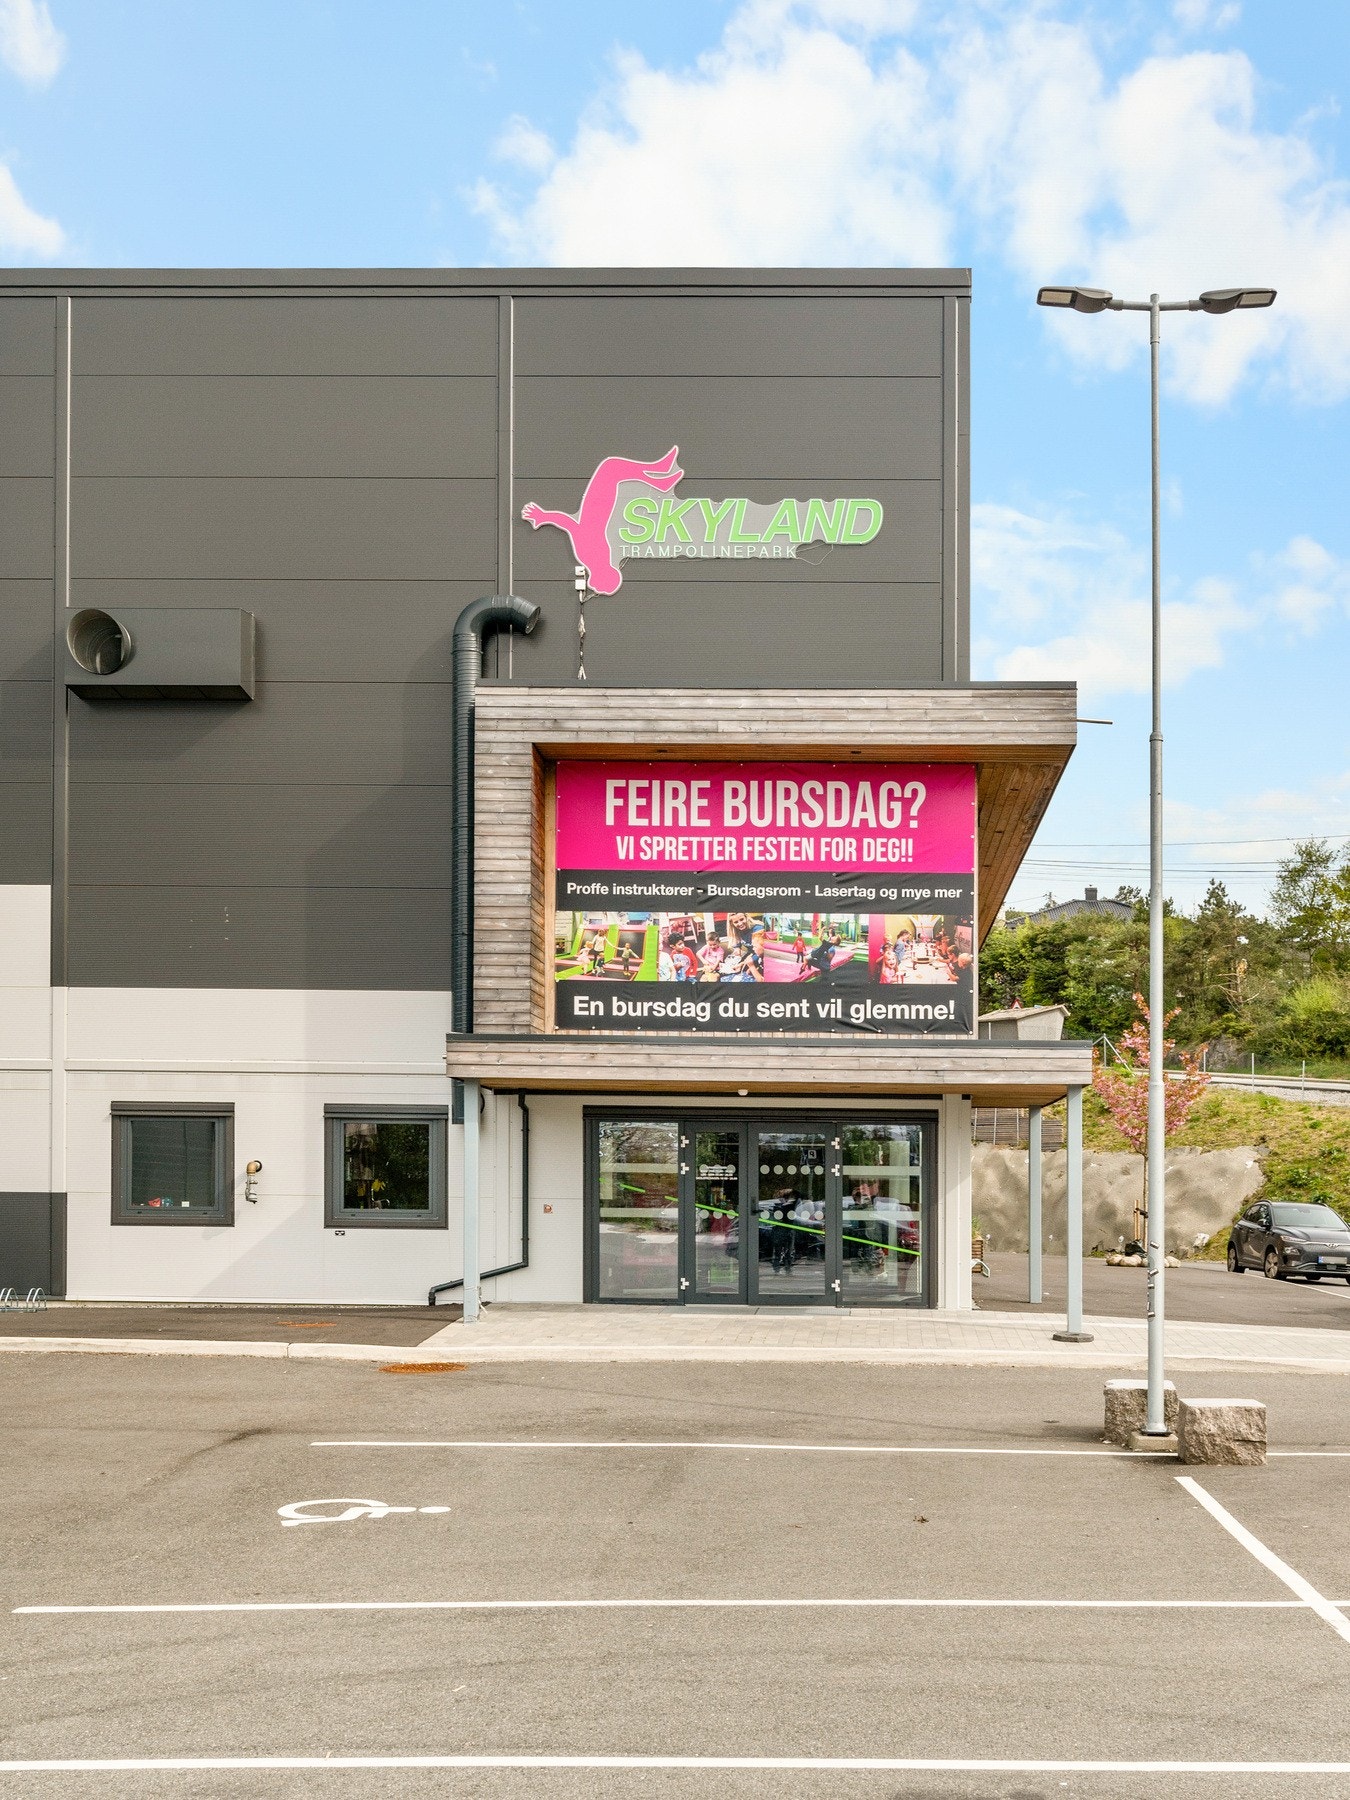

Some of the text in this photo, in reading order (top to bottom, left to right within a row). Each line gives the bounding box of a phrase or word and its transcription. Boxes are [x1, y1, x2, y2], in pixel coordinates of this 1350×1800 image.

[619, 498, 883, 544] SKYLAND
[620, 545, 797, 557] TRAMPOLINEPARK
[605, 779, 927, 829] FEIRE BURSDAG?
[616, 835, 914, 863] VI SPRETTER FESTEN FOR DEG!!
[566, 882, 610, 896] Proffe
[612, 883, 695, 897] instruktører
[707, 883, 802, 899] Bursdagsrom
[814, 884, 876, 901] Lasertag
[879, 888, 898, 901] og
[901, 888, 932, 901] mye
[934, 888, 964, 899] mer
[573, 995, 956, 1024] En bursdag du sent vil glemme!
